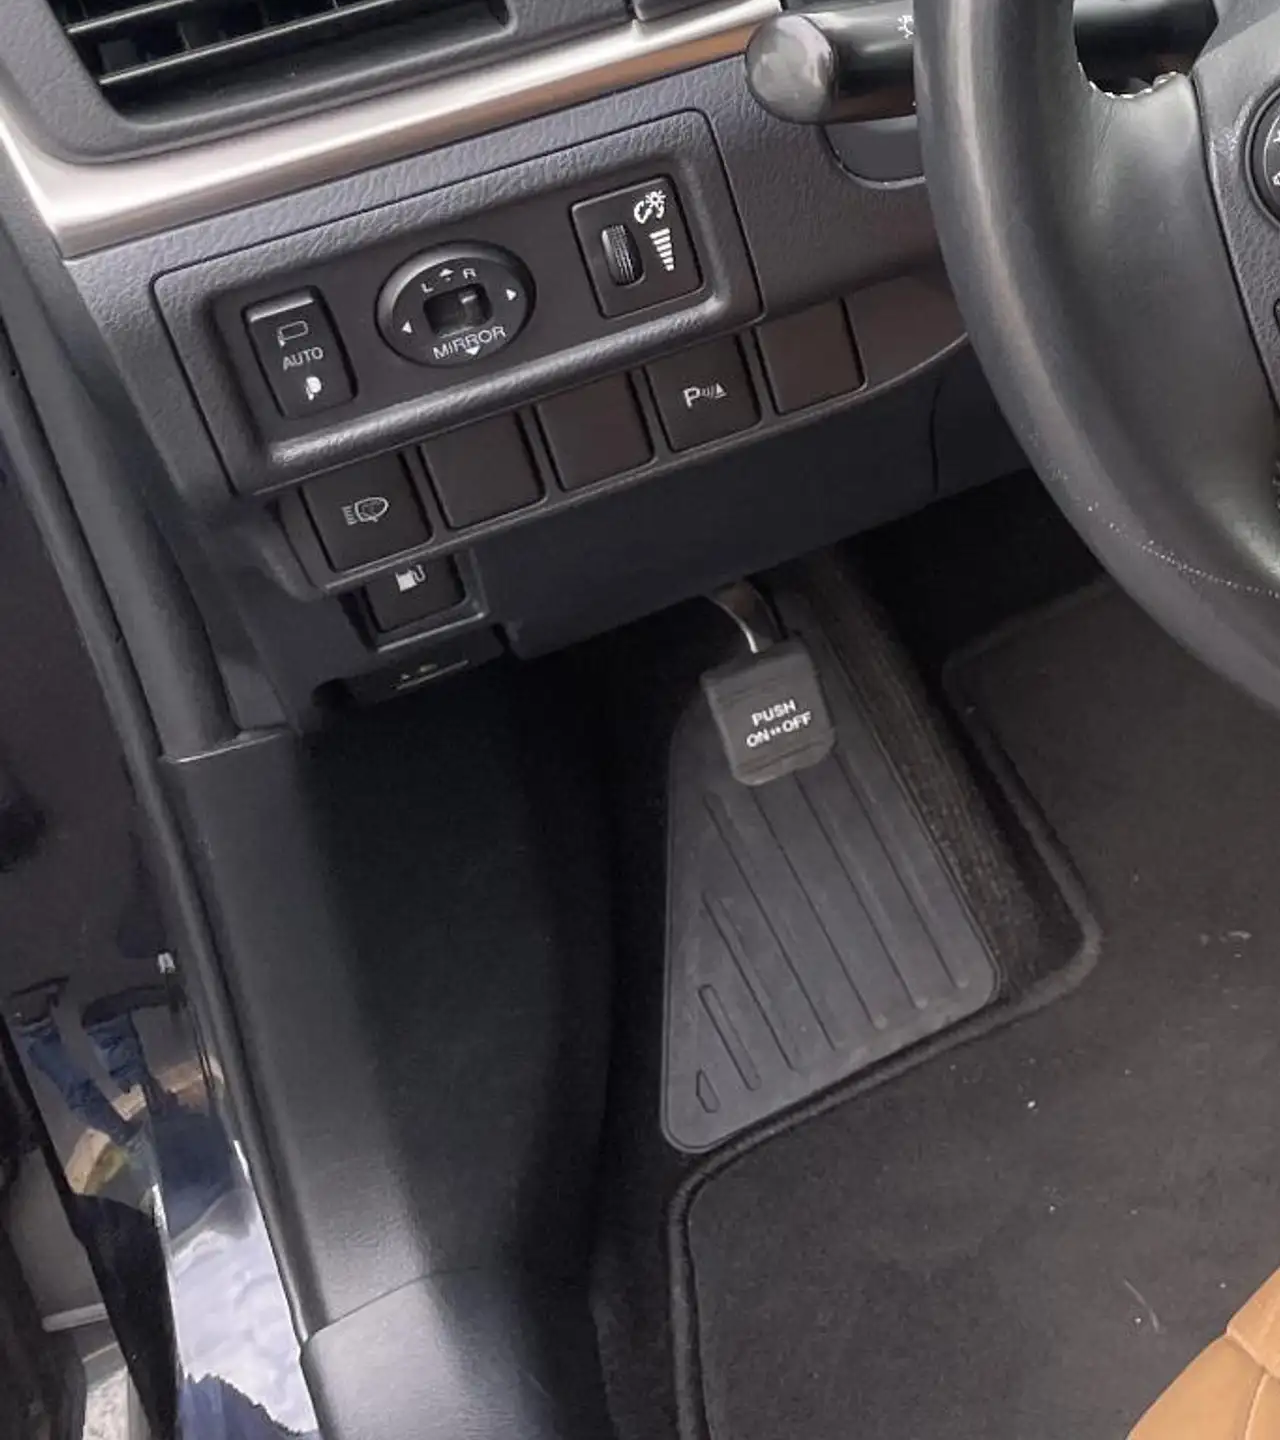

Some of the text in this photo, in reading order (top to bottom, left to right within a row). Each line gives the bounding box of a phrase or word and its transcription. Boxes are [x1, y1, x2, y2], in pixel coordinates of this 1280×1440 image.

[421, 268, 476, 293] L R
[432, 325, 507, 360] MIRROR
[282, 346, 324, 371] AUTO
[751, 698, 797, 727] PUSH
